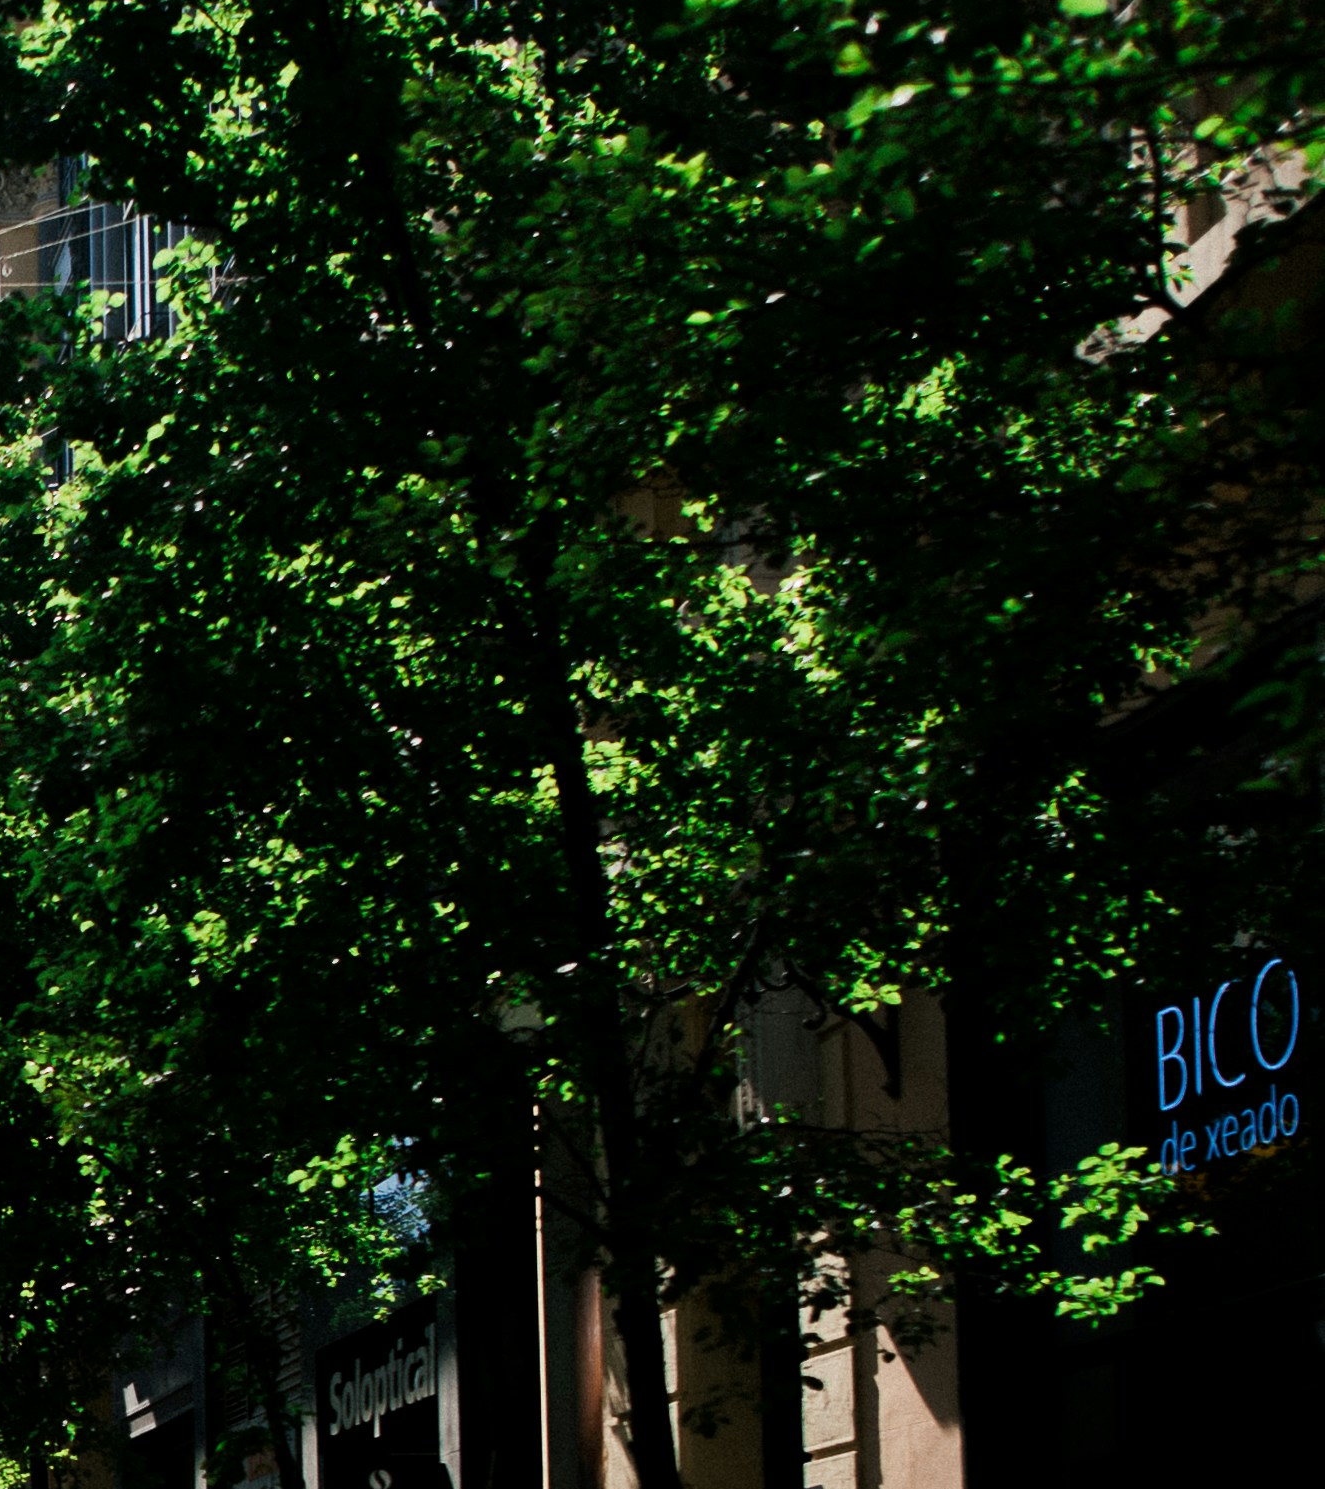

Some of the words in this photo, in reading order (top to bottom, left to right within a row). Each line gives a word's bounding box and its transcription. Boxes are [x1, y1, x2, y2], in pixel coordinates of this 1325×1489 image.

[1156, 956, 1300, 1112] BICO
[1160, 1120, 1198, 1176] de
[1203, 1083, 1300, 1162] xeado
[328, 1321, 437, 1440] Soloptical
